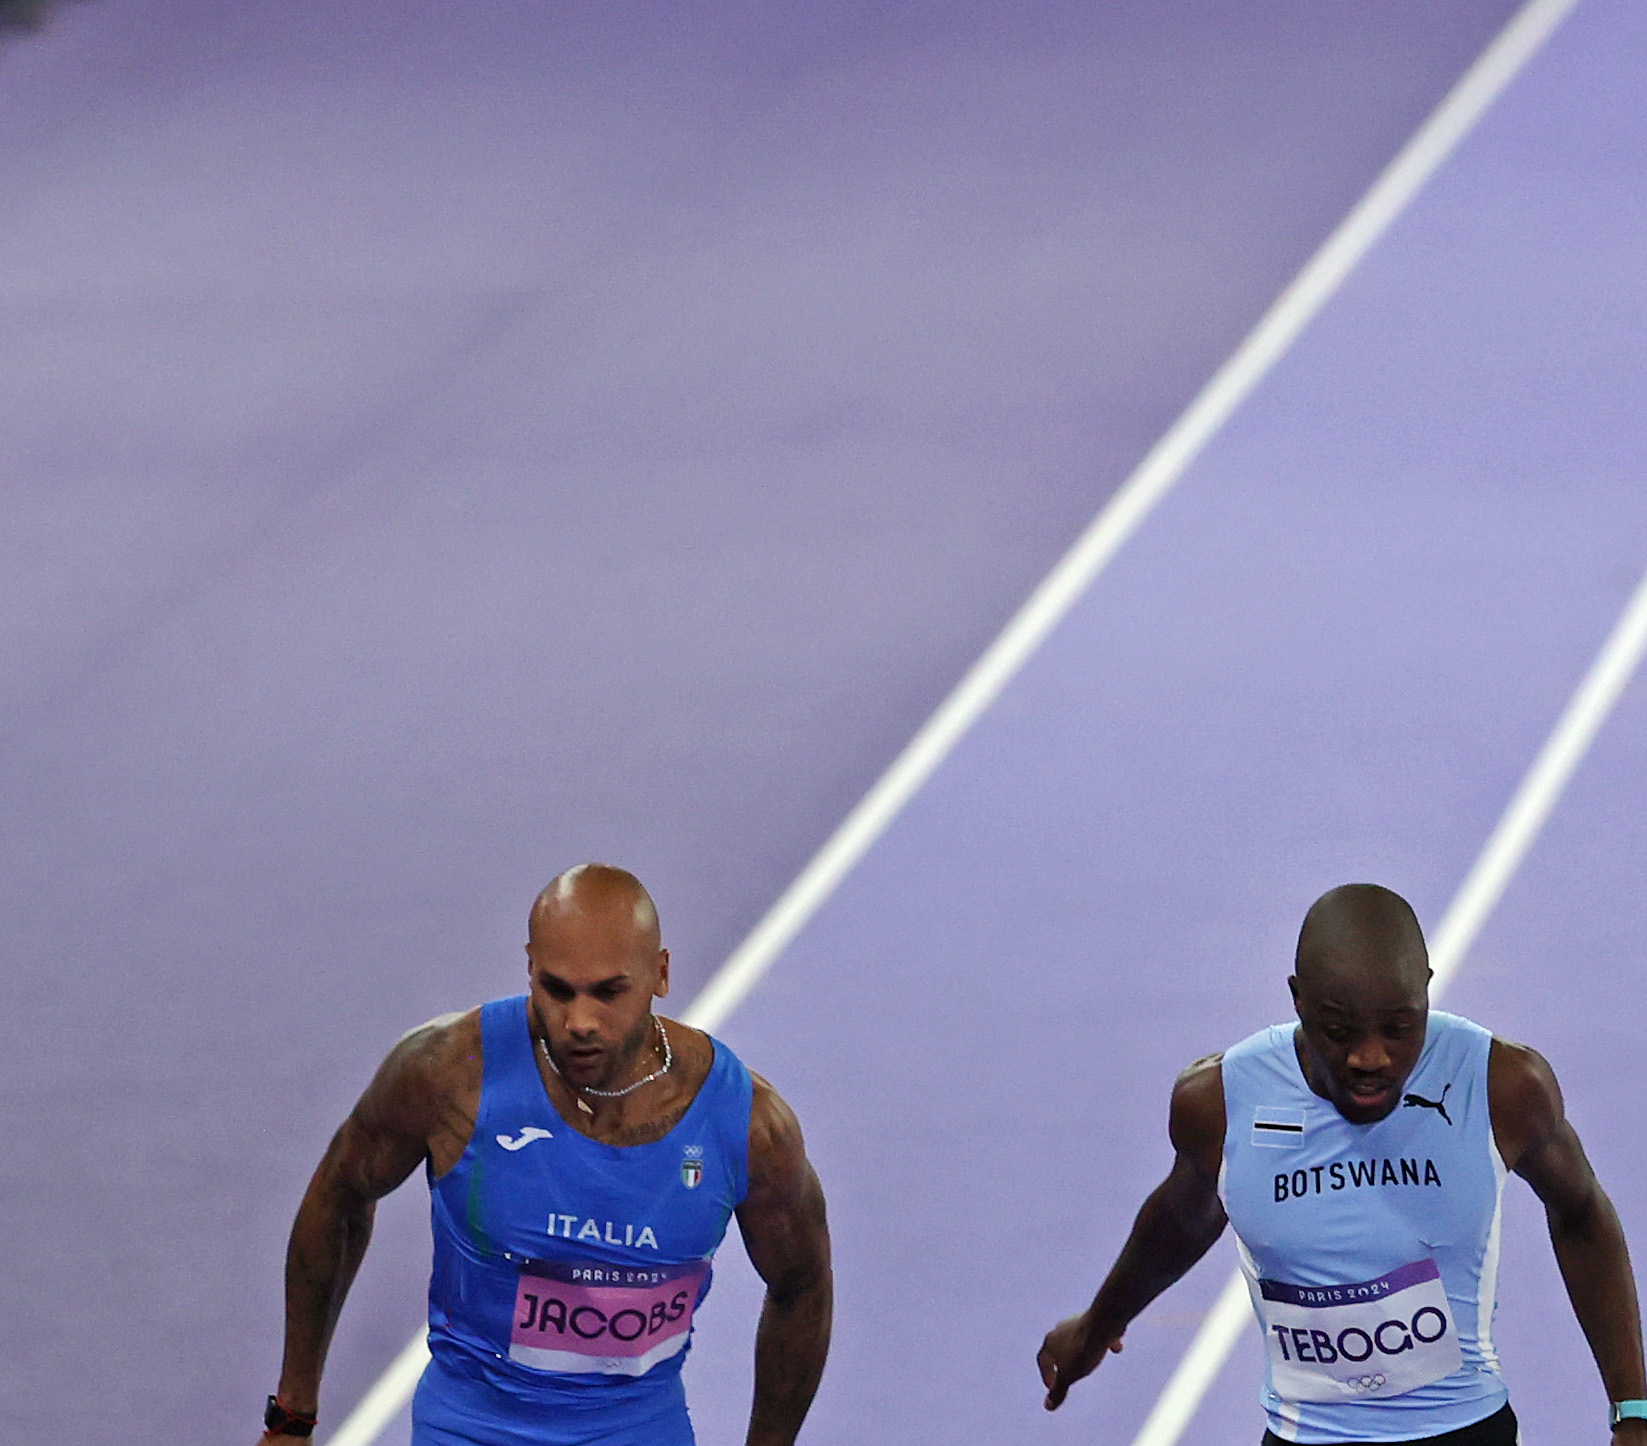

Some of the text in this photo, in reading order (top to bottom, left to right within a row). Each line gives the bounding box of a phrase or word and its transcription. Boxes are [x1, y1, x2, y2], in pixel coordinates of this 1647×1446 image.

[1274, 1158, 1441, 1202] BOTSWANA
[547, 1213, 659, 1249] ITALIA
[572, 1268, 620, 1282] PARIS
[1298, 1282, 1389, 1302] PARIS 2024
[520, 1291, 688, 1341] JACOBS
[1272, 1306, 1447, 1364] TEBOGO
